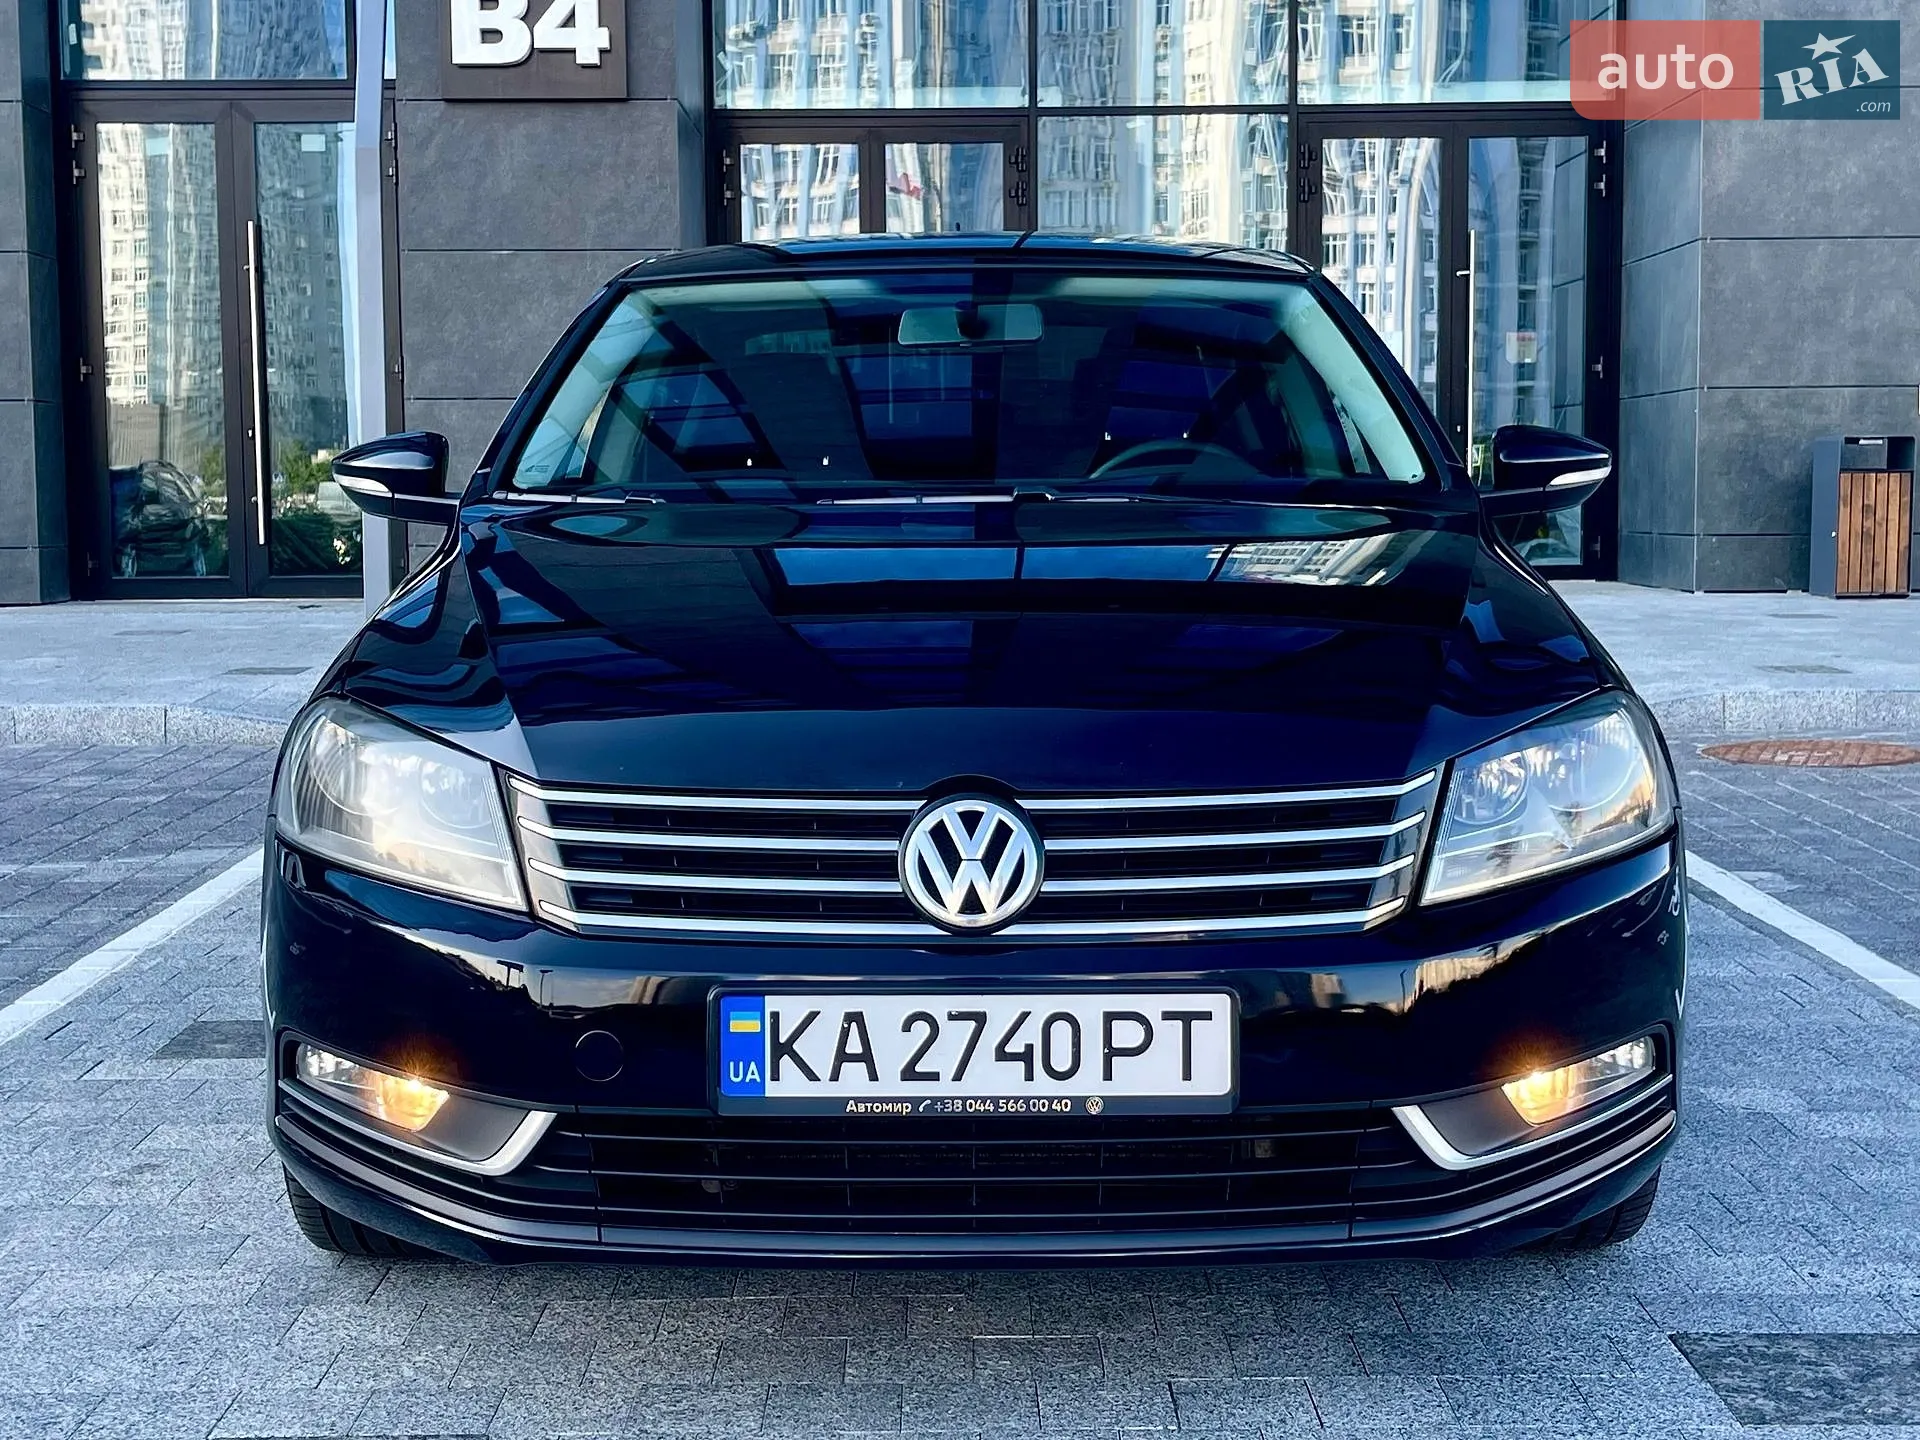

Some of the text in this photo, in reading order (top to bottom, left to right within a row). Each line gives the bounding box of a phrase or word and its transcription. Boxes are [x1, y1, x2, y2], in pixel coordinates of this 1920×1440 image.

[450, 0, 611, 67] B4
[769, 1010, 1213, 1083] KA 2740 PT
[729, 1062, 761, 1083] UA
[845, 1099, 1072, 1116] Автомир +38 044 566 00 40
